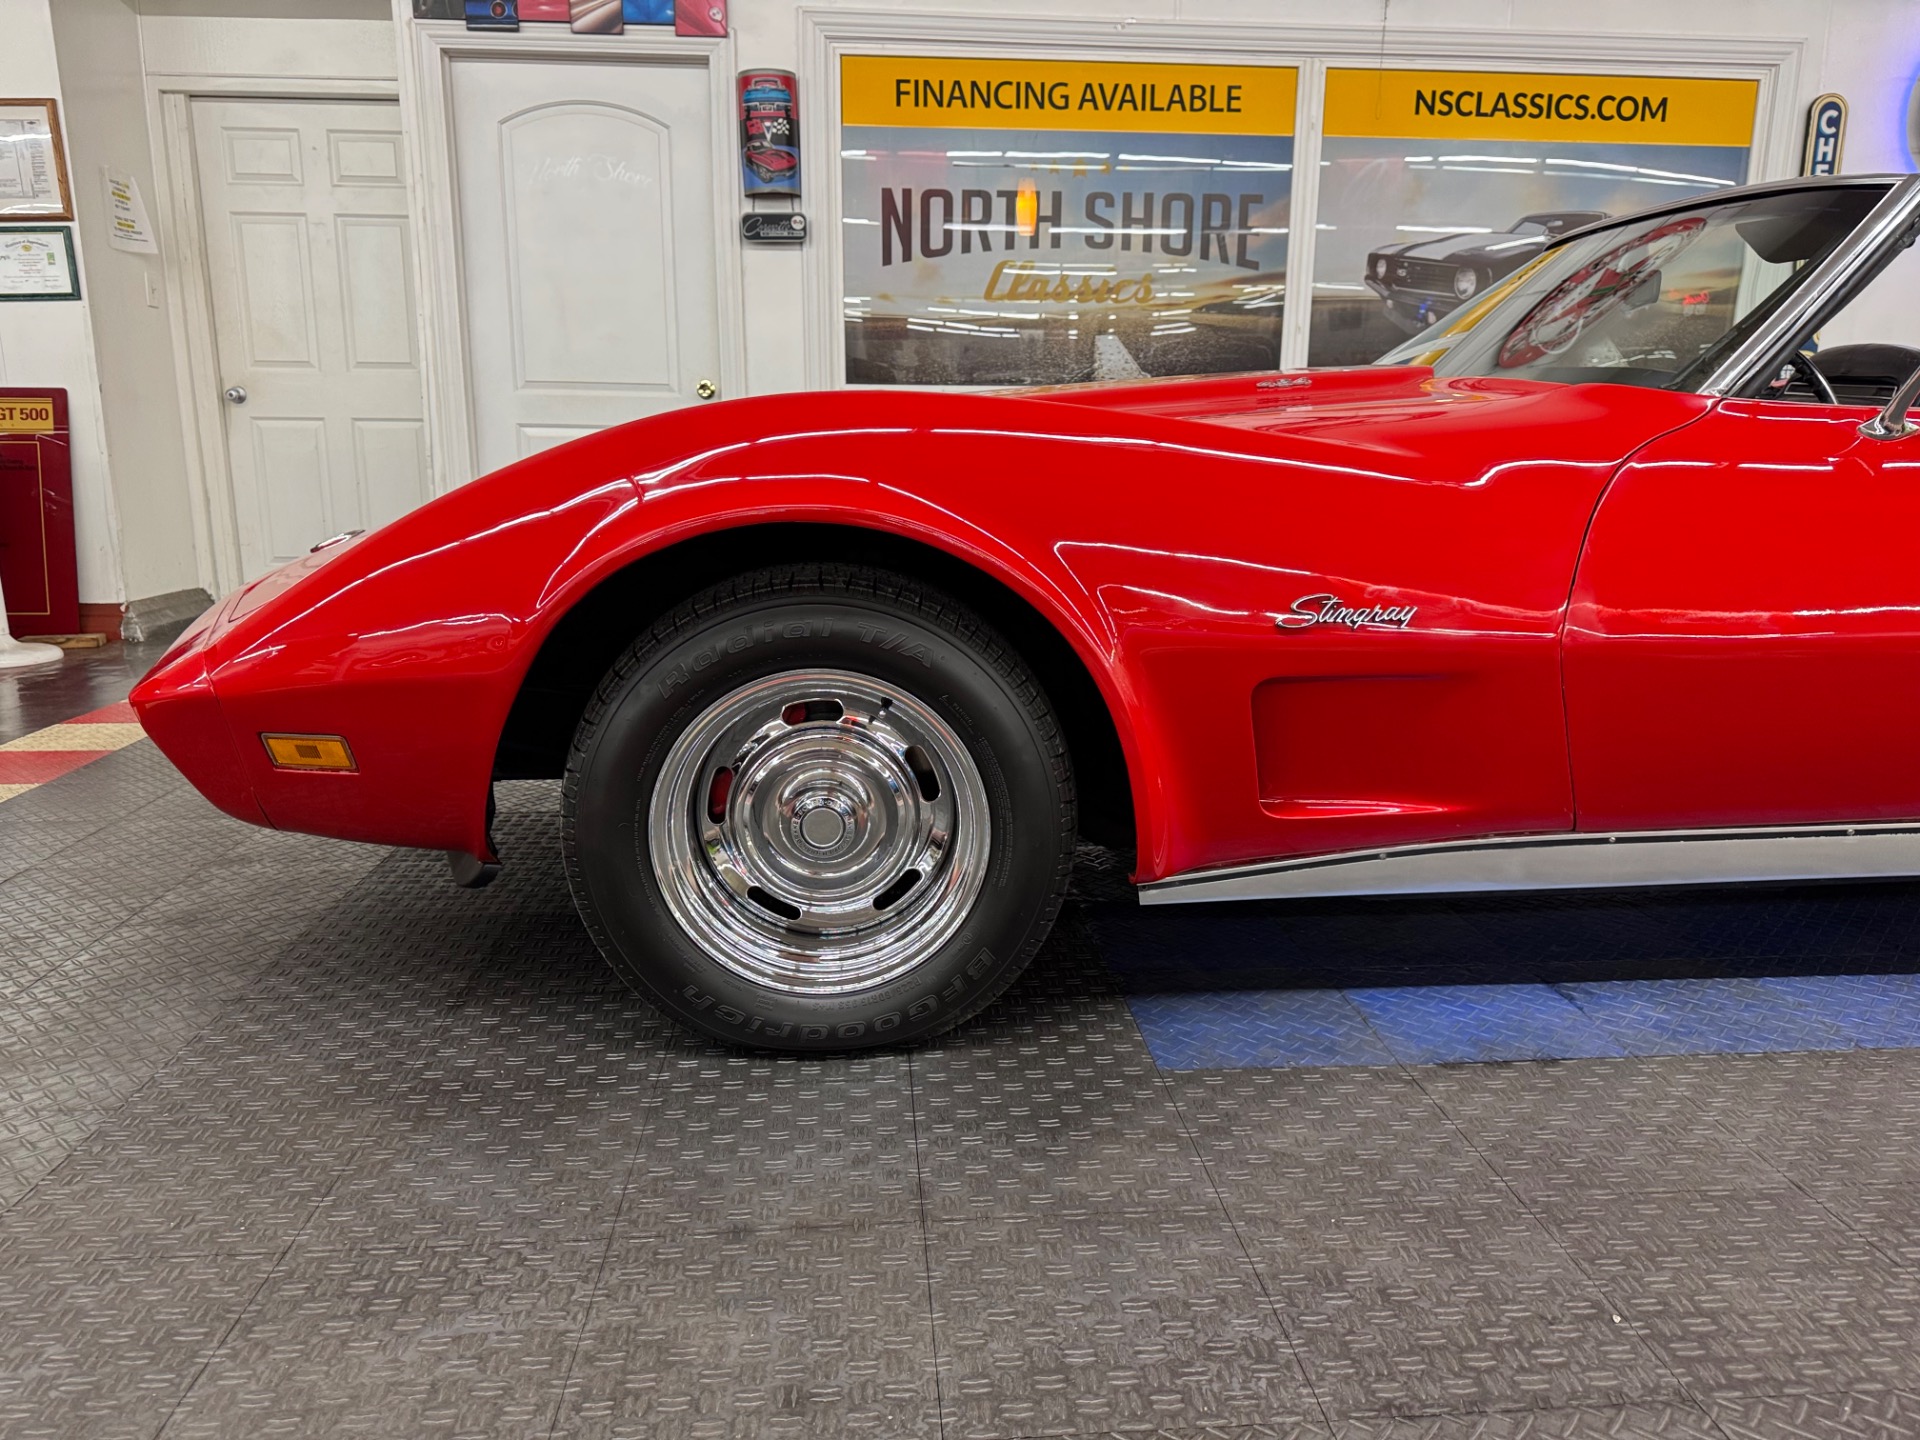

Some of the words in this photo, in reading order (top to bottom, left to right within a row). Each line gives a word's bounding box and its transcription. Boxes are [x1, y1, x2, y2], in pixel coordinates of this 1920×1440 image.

[895, 78, 1070, 110] FINANCING
[1077, 82, 1242, 113] AVAILABLE
[1414, 89, 1669, 122] NSCLASSICS.COM
[880, 187, 1063, 267] NORTH
[1084, 192, 1264, 271] SHORE
[983, 259, 1157, 304] Classics
[19, 407, 49, 421] 500
[1275, 592, 1418, 629] Stingray
[656, 617, 837, 699] Radial
[857, 621, 938, 669] T/A
